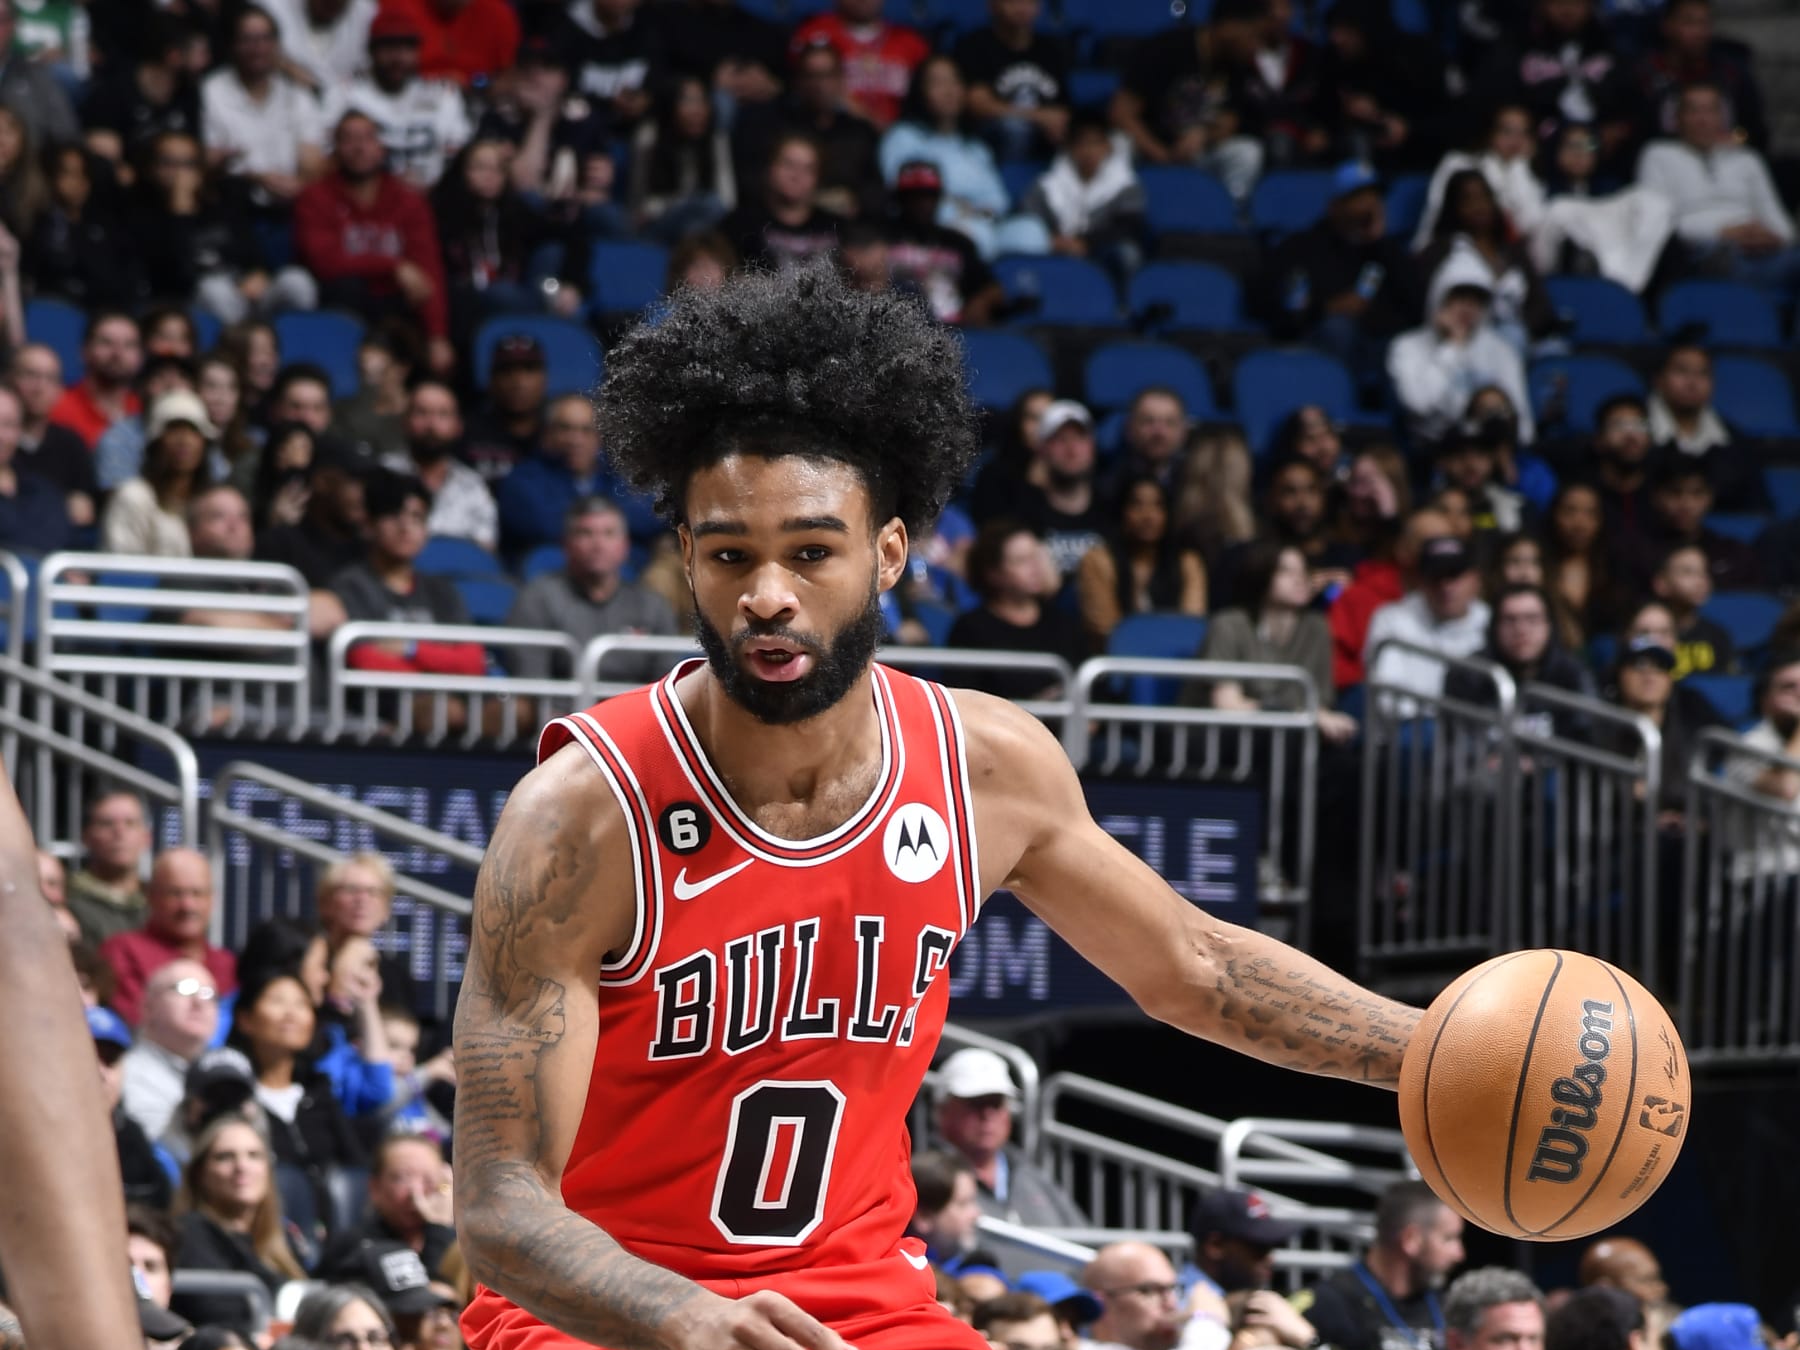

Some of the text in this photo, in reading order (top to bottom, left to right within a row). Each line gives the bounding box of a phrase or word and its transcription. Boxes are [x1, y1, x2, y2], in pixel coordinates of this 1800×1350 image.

[669, 809, 700, 850] 6
[648, 915, 956, 1061] BULLS
[709, 1079, 847, 1247] 0
[1526, 998, 1614, 1184] Wilson
